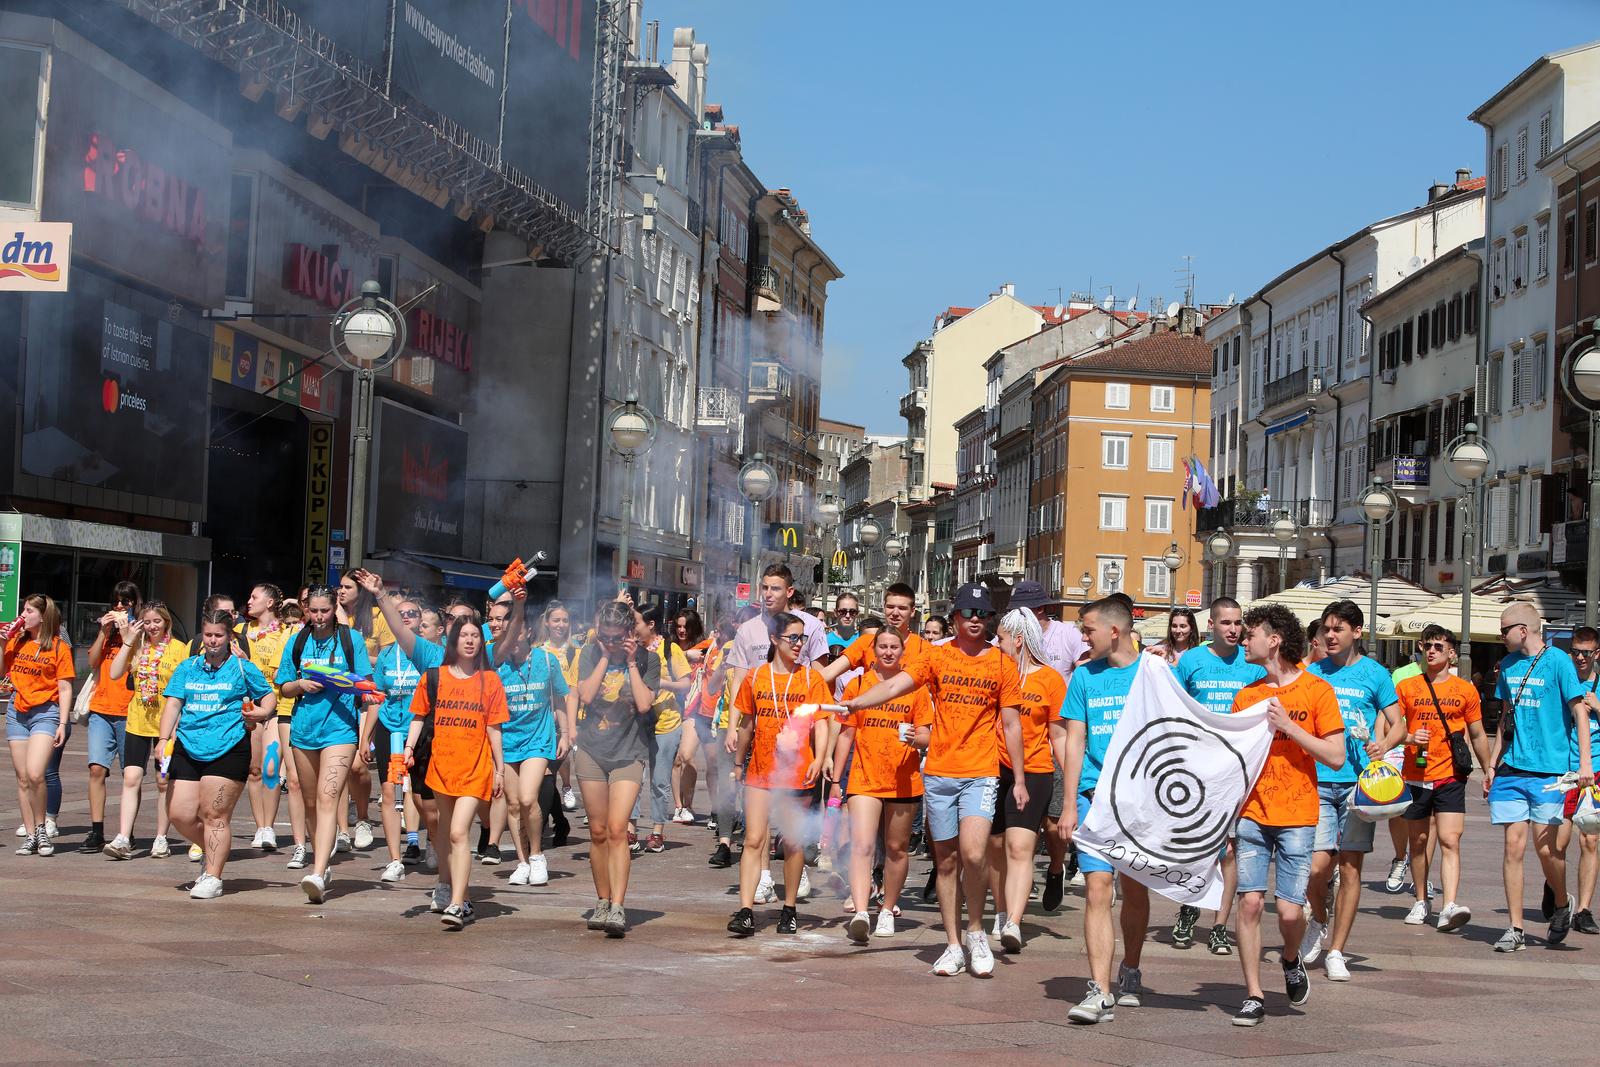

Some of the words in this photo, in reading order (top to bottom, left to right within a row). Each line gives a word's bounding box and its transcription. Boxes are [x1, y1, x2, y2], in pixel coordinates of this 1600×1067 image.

[404, 1, 495, 88] www.newyorker.fashion
[2, 231, 53, 264] dm
[104, 317, 112, 334] To
[113, 322, 128, 340] taste
[129, 328, 139, 343] the
[140, 331, 152, 348] best
[416, 308, 473, 371] RIJEKA
[102, 343, 110, 358] of
[111, 345, 130, 364] Istrian
[120, 389, 146, 411] priceless
[311, 428, 329, 513] OTKUP
[1399, 460, 1427, 468] HAPPY
[942, 674, 998, 691] BARATAMO
[1195, 680, 1217, 689] RAGAZZI
[757, 690, 806, 703] BARATAMO
[943, 692, 989, 707] JEZICIMA
[1207, 691, 1214, 700] AU
[1215, 691, 1233, 700] REVOIR,
[1334, 686, 1365, 698] TRANQUILO
[1088, 695, 1113, 708] RAGAZZI
[435, 716, 477, 729] JEZICIMA
[1103, 710, 1111, 720] AU
[1091, 722, 1113, 736] SCHÖN
[1100, 839, 1206, 894] 2019-2023
